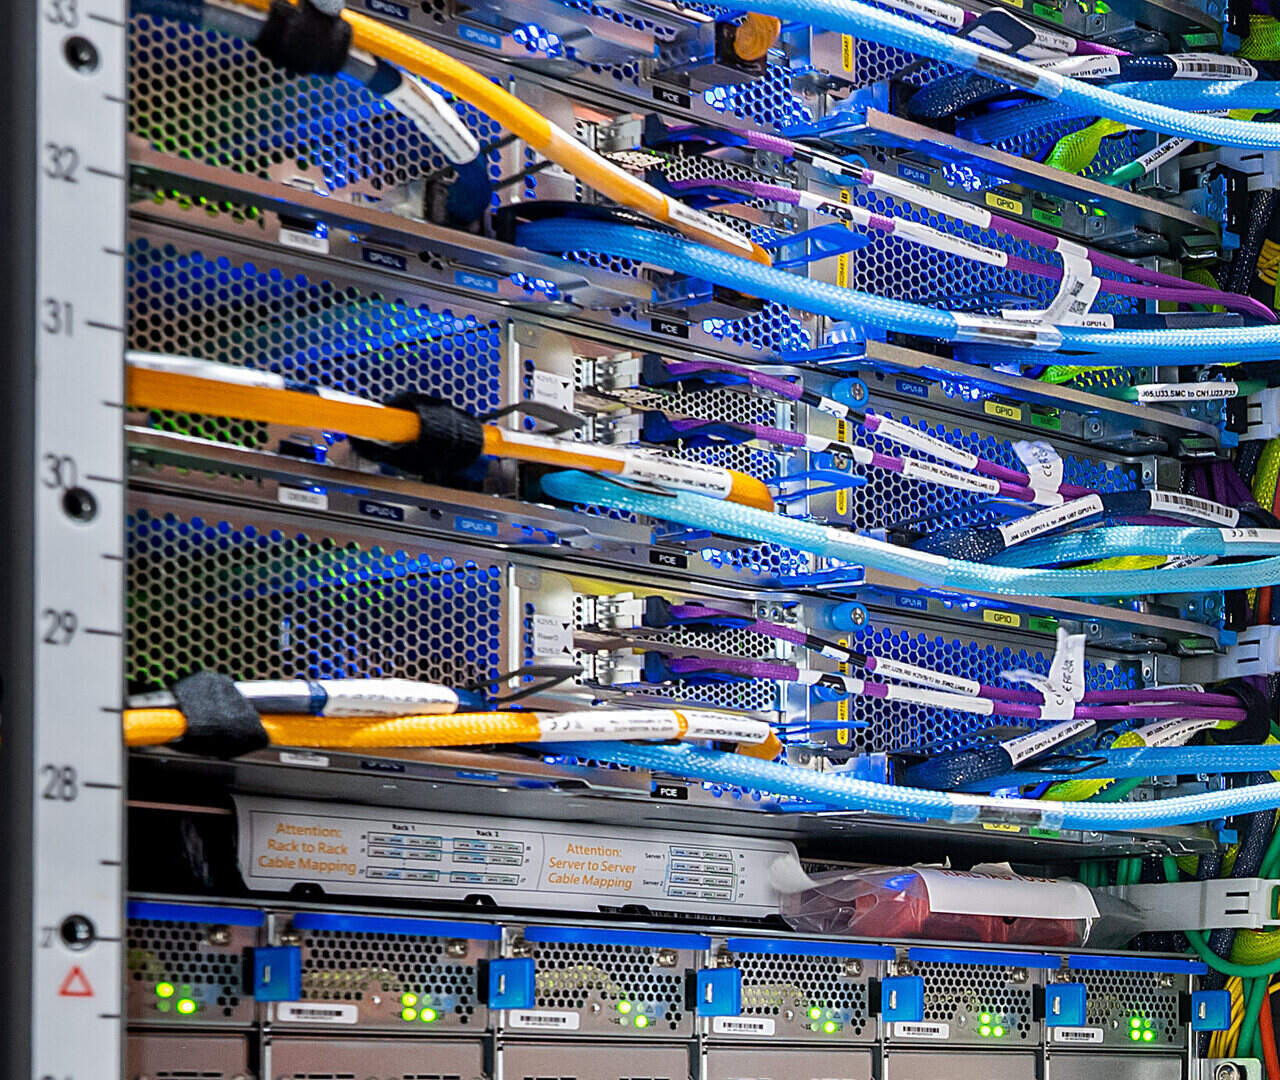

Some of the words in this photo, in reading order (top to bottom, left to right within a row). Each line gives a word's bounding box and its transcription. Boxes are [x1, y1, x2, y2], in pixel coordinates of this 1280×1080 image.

[43, 143, 79, 183] 32
[995, 197, 1015, 210] GPIO
[43, 297, 73, 337] 31
[994, 405, 1013, 418] GPIO
[43, 453, 79, 489] 30
[43, 608, 78, 646] 29
[993, 613, 1013, 624] GPIO
[42, 764, 78, 802] 28
[275, 822, 342, 839] Attention:
[267, 838, 297, 851] Rack
[300, 842, 315, 853] to
[317, 841, 348, 855] Rack
[566, 843, 622, 857] Attention:
[257, 855, 296, 869] Cable
[299, 857, 357, 875] Mapping
[549, 856, 588, 871] Server
[587, 860, 600, 872] to
[601, 859, 637, 874] Server
[547, 872, 580, 886] Cable
[582, 874, 633, 891] Mapping
